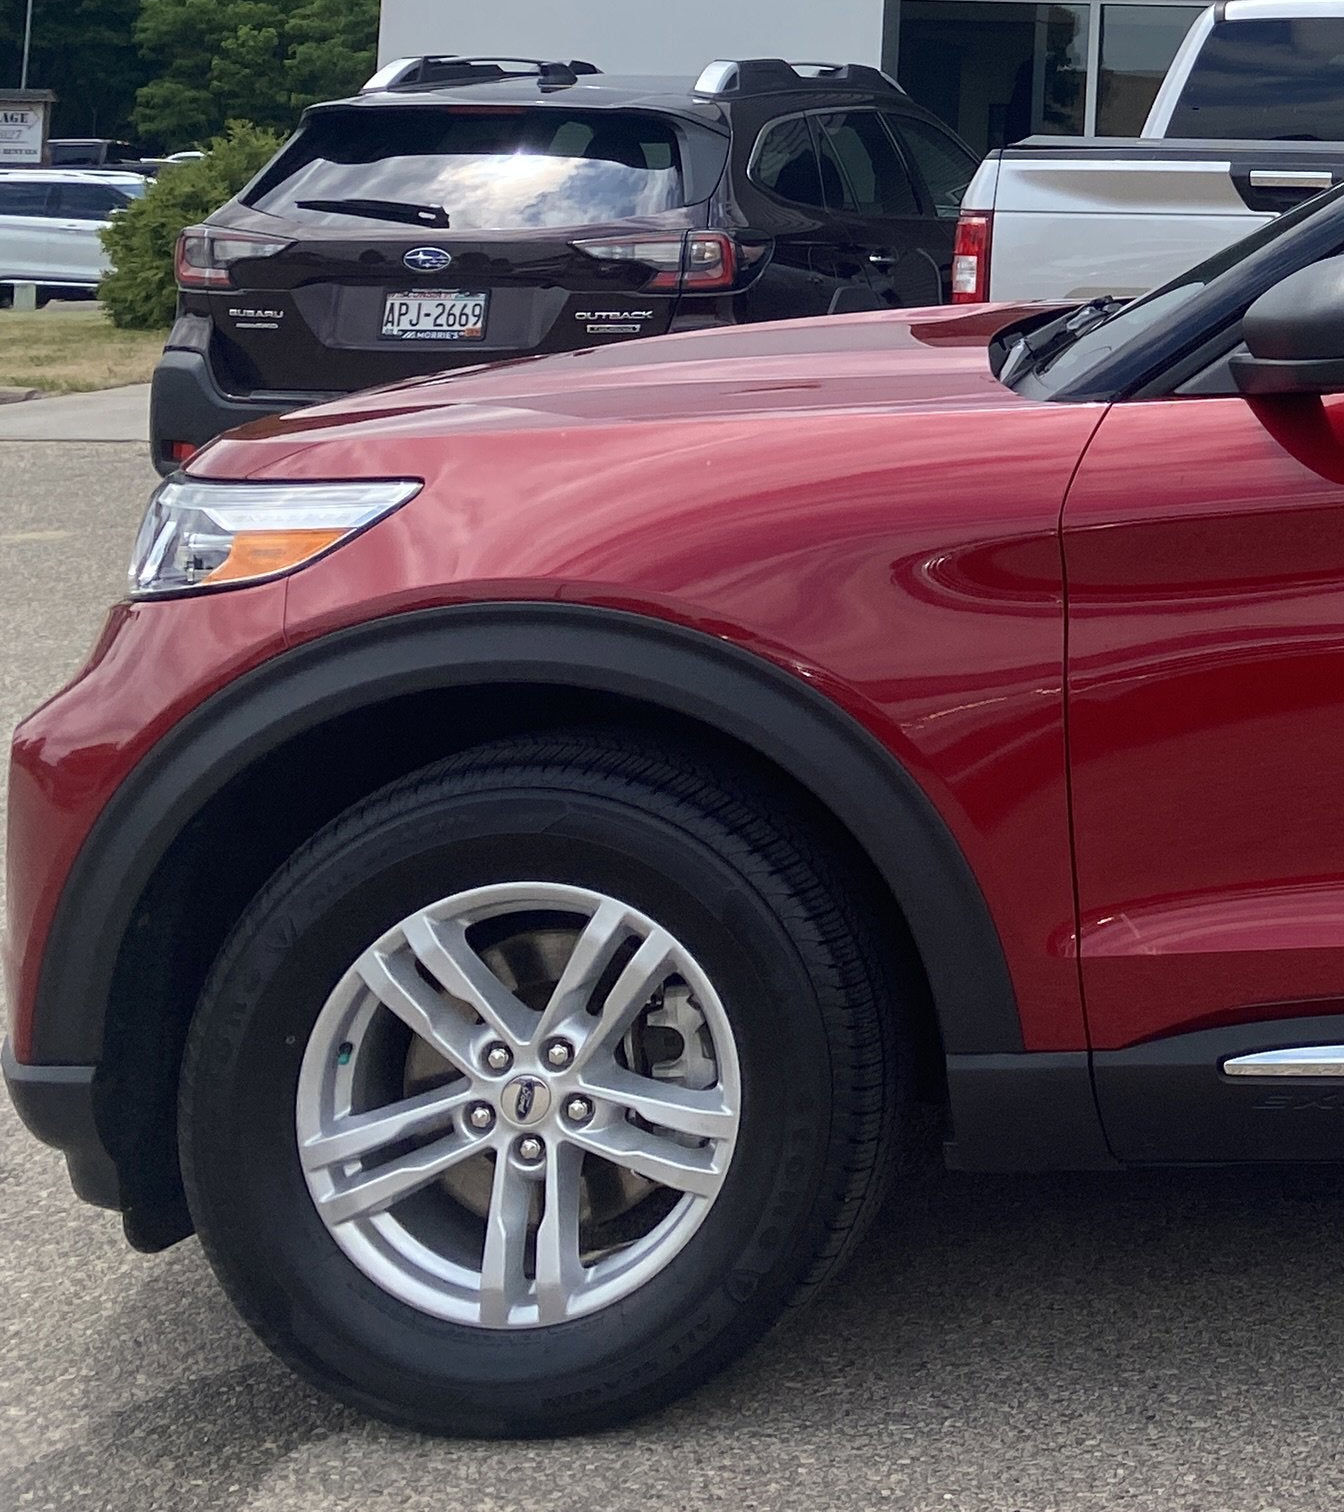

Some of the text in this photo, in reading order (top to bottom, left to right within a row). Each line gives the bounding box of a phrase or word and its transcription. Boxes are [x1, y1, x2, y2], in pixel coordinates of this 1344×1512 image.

[229, 308, 284, 319] SUBARU
[384, 302, 482, 328] APJ-2669
[575, 310, 654, 320] OUTBACK
